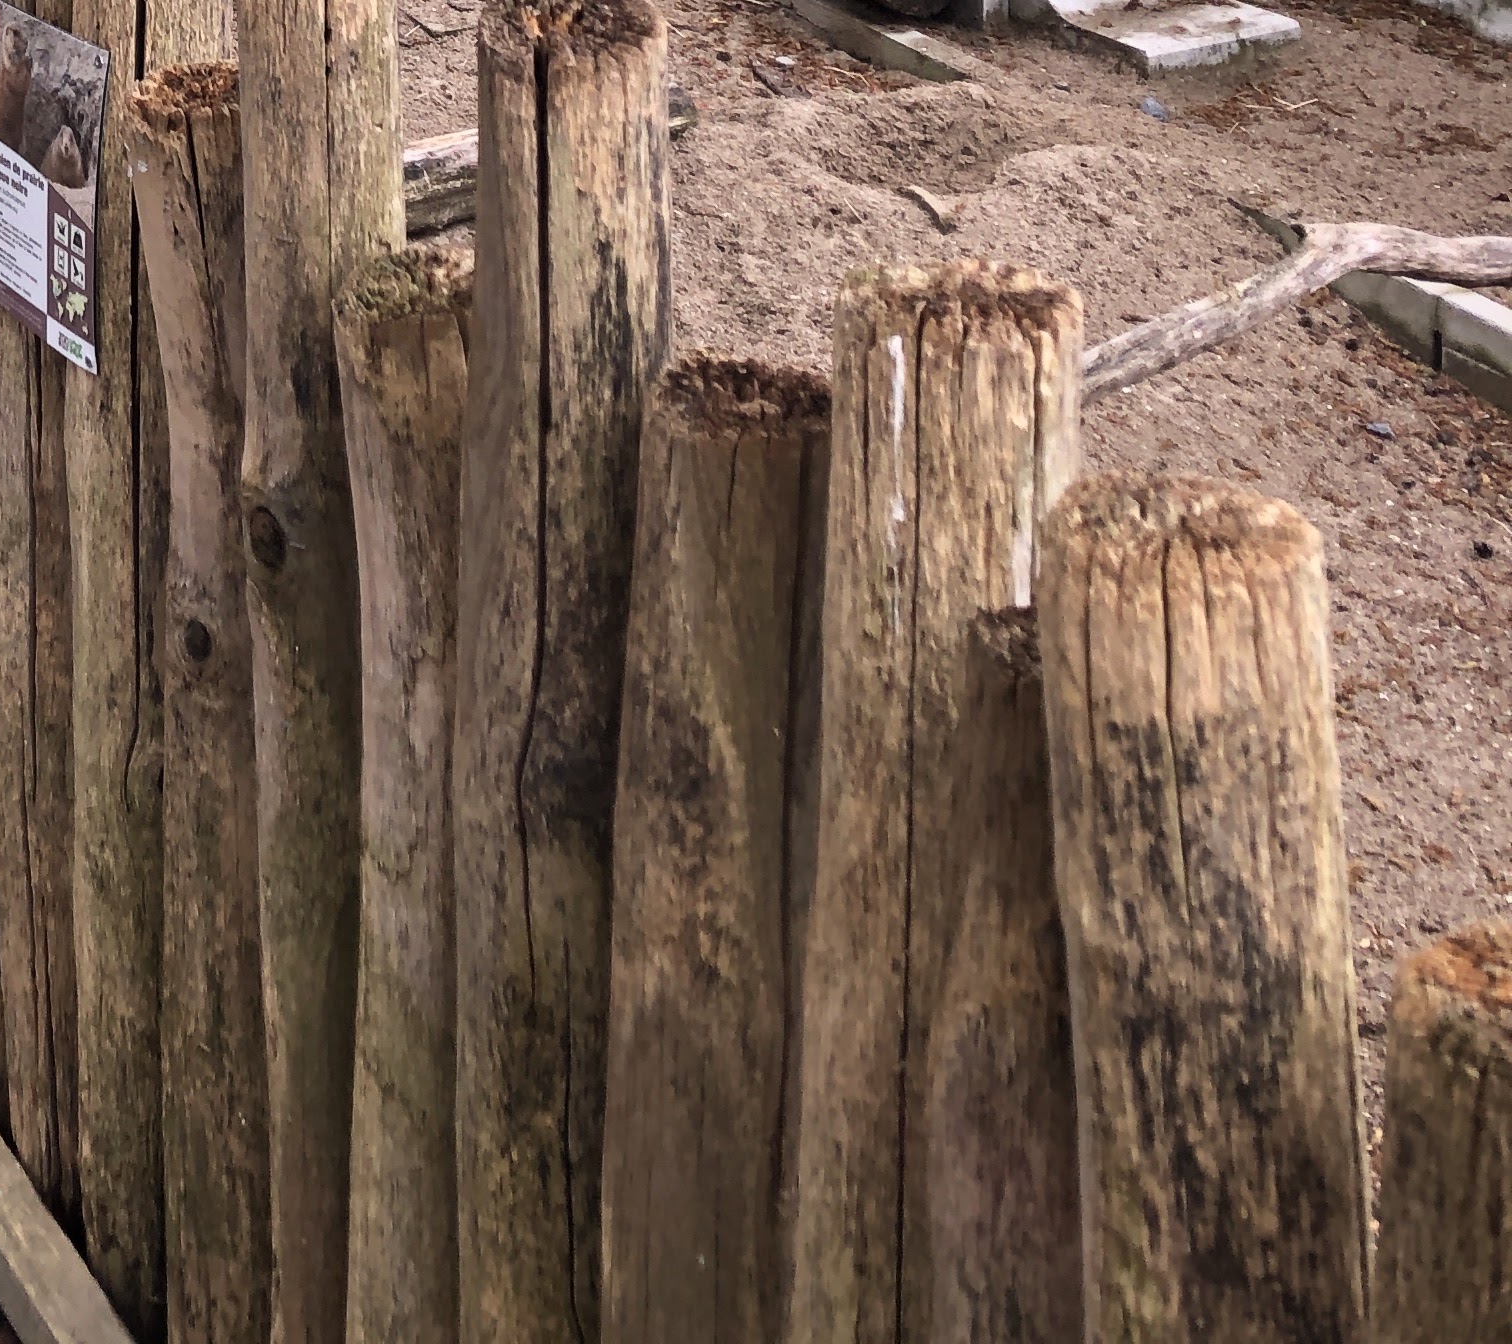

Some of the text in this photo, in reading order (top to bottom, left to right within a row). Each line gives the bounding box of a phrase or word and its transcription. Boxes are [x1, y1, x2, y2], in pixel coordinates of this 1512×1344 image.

[11, 178, 28, 197] noire
[12, 162, 21, 176] de
[22, 169, 45, 191] prairie
